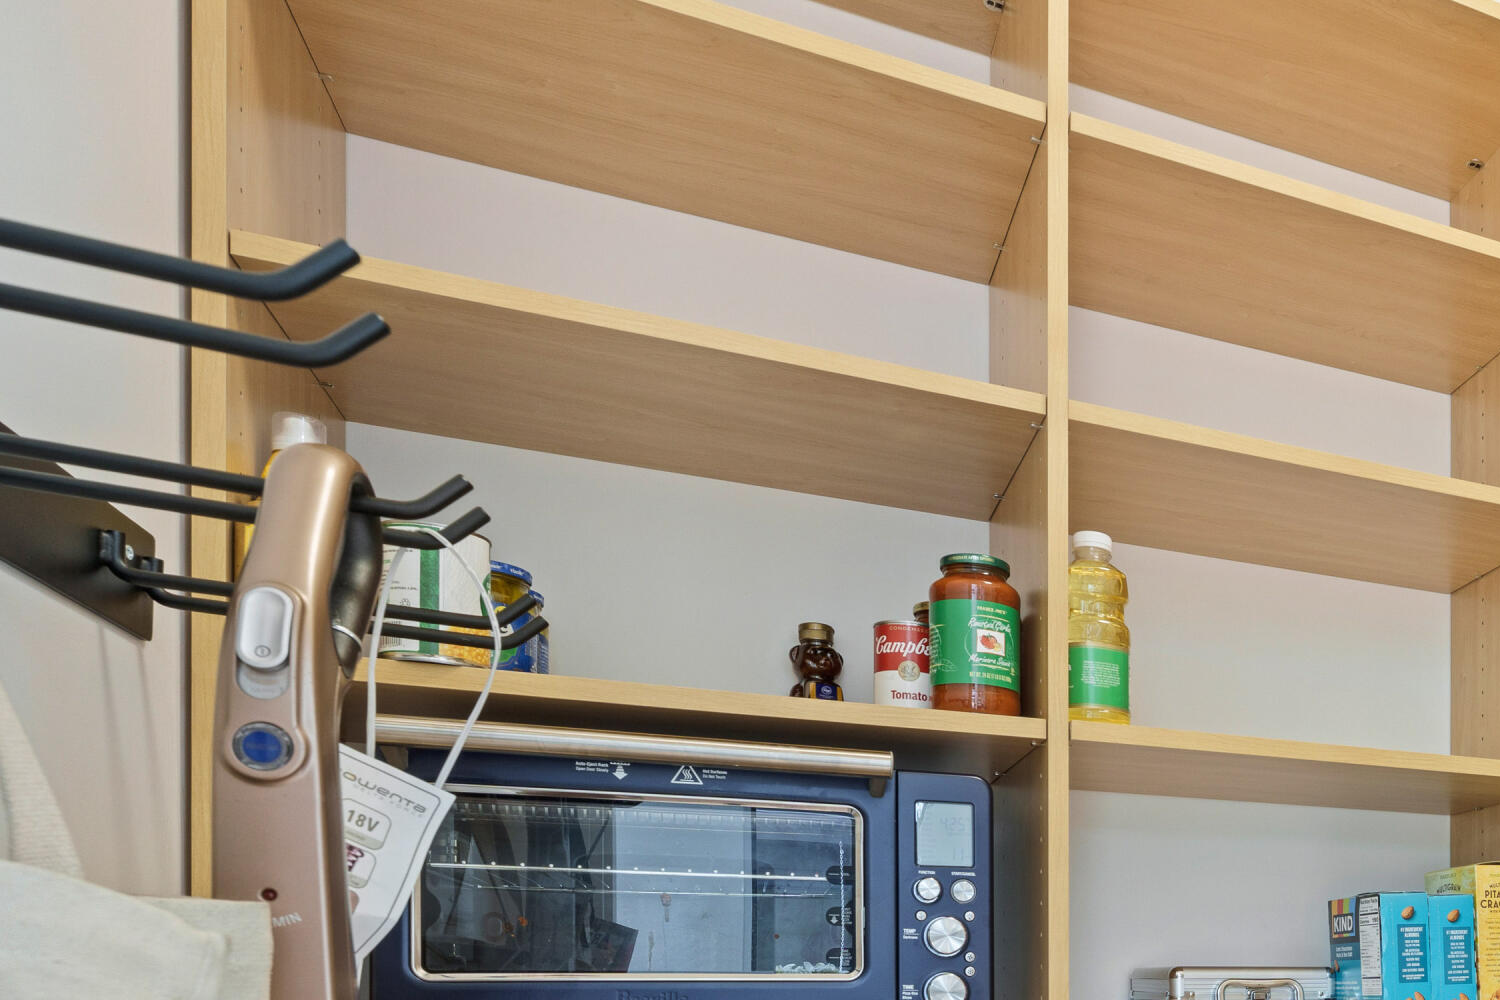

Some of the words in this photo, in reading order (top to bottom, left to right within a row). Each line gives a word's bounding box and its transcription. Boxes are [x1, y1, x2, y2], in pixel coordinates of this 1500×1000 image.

[876, 635, 931, 657] Campbe
[891, 690, 928, 701] Tomato
[340, 768, 426, 814] owenta
[346, 809, 380, 833] 18V
[1333, 915, 1353, 933] KIND
